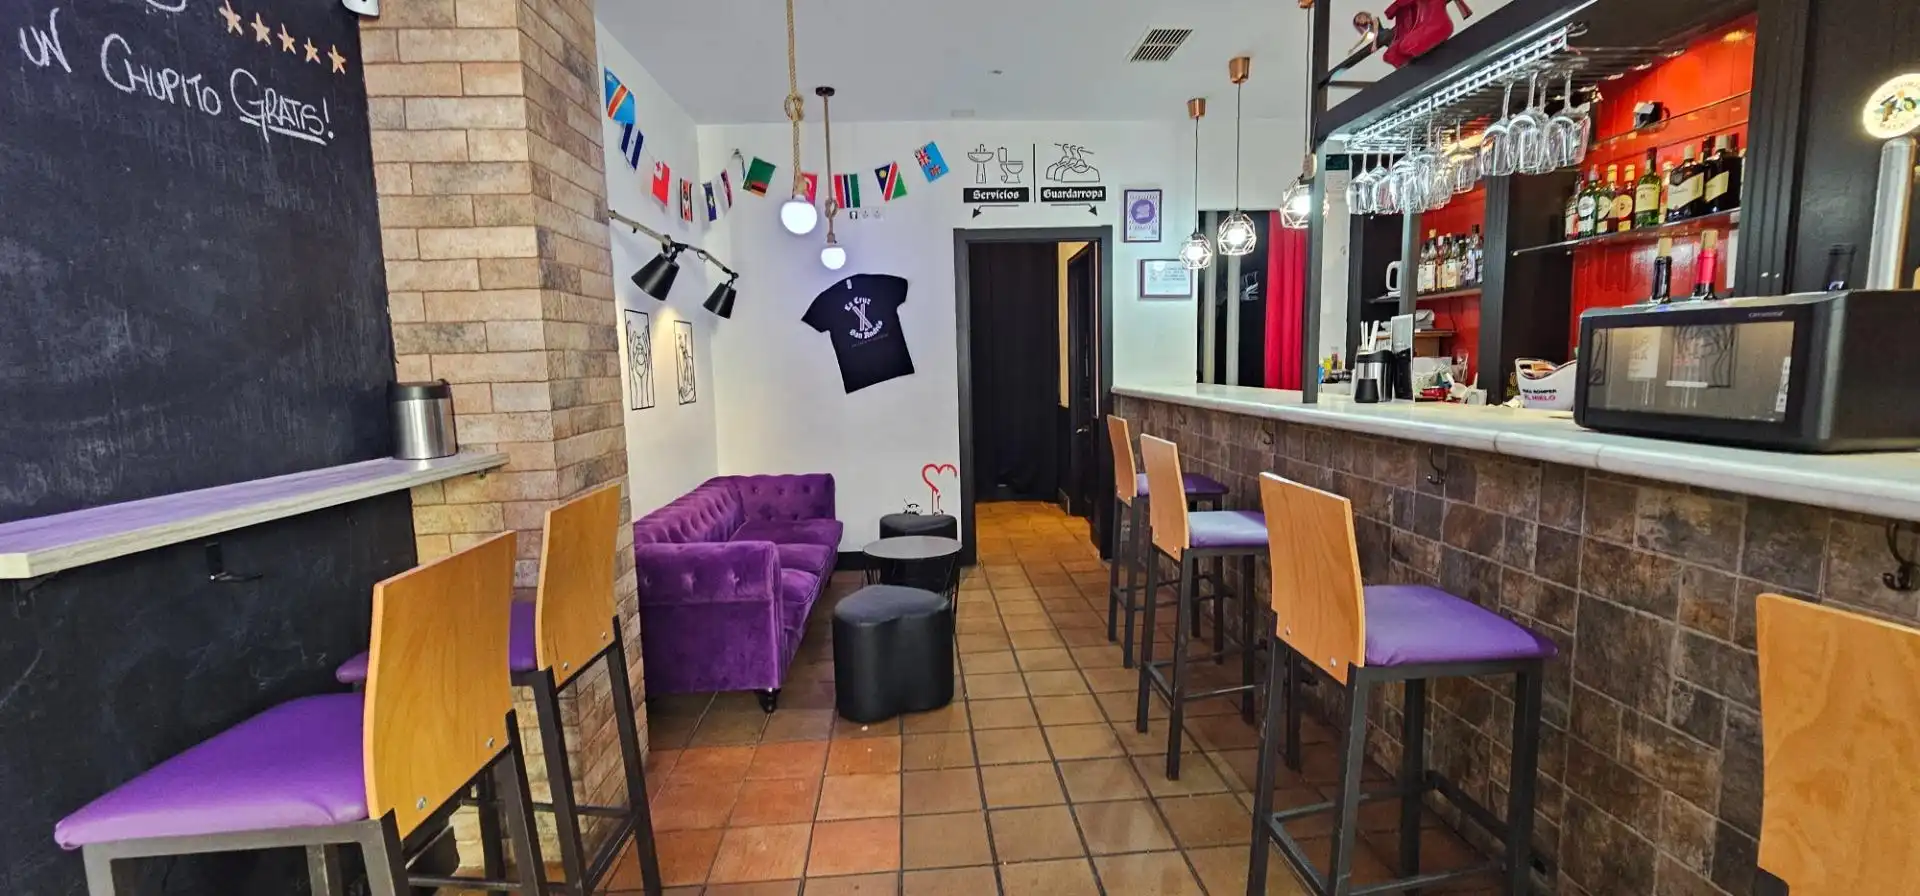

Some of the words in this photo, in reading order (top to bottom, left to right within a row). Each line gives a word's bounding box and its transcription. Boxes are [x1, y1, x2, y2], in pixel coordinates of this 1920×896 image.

[20, 8, 72, 73] UN
[101, 33, 221, 116] CHUPITO
[230, 68, 334, 143] GRATIS!
[972, 189, 1020, 200] Servicios
[1043, 188, 1103, 199] Guardarropa
